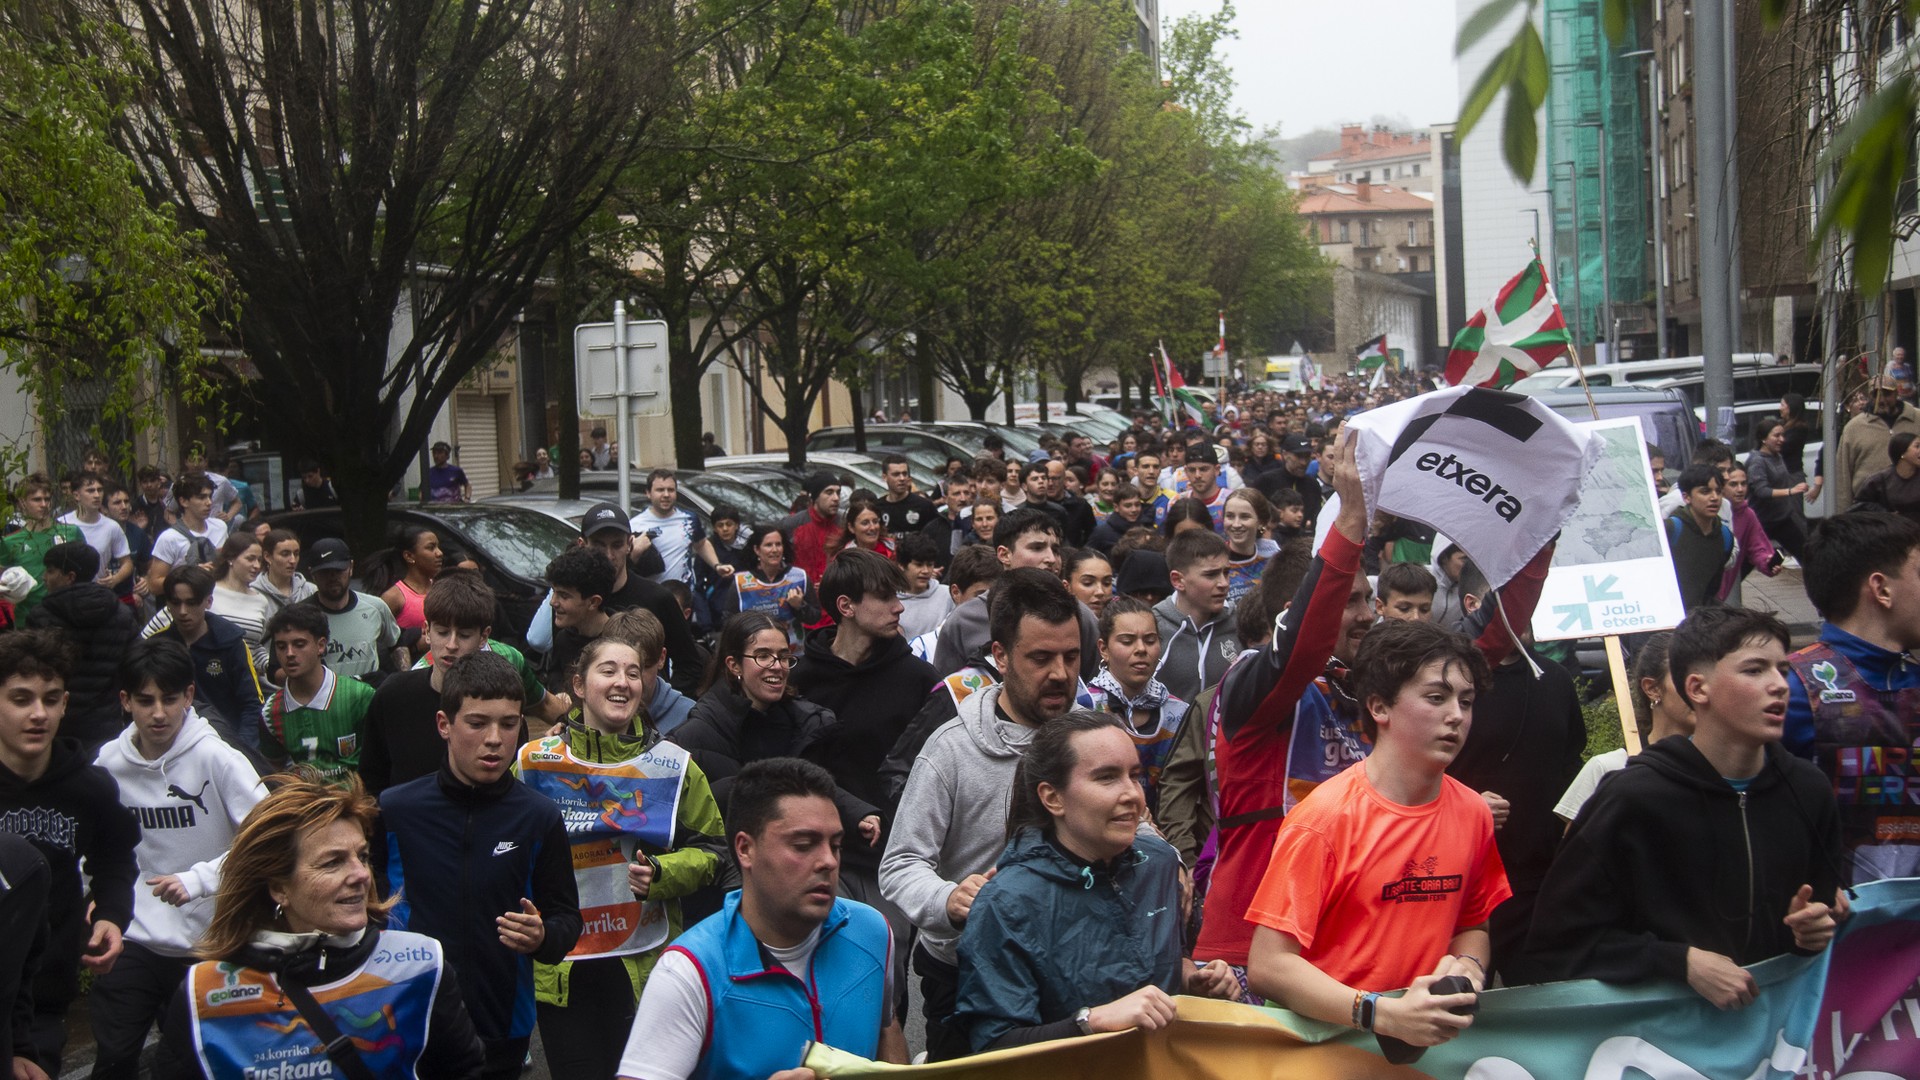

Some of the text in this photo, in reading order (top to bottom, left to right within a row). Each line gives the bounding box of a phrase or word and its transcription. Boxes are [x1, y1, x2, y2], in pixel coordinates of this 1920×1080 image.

[1415, 451, 1523, 523] etxera
[1601, 600, 1641, 617] Jabi
[1602, 612, 1656, 629] etxera
[653, 756, 681, 771] eitb
[128, 805, 197, 829] PUMA
[560, 806, 599, 821] skara
[564, 821, 595, 832] ara
[574, 848, 606, 860] ABORAL
[581, 912, 628, 936] rrika
[394, 947, 433, 962] eitb
[254, 1044, 310, 1063] 24.korrika
[243, 1060, 333, 1080] Euskara
